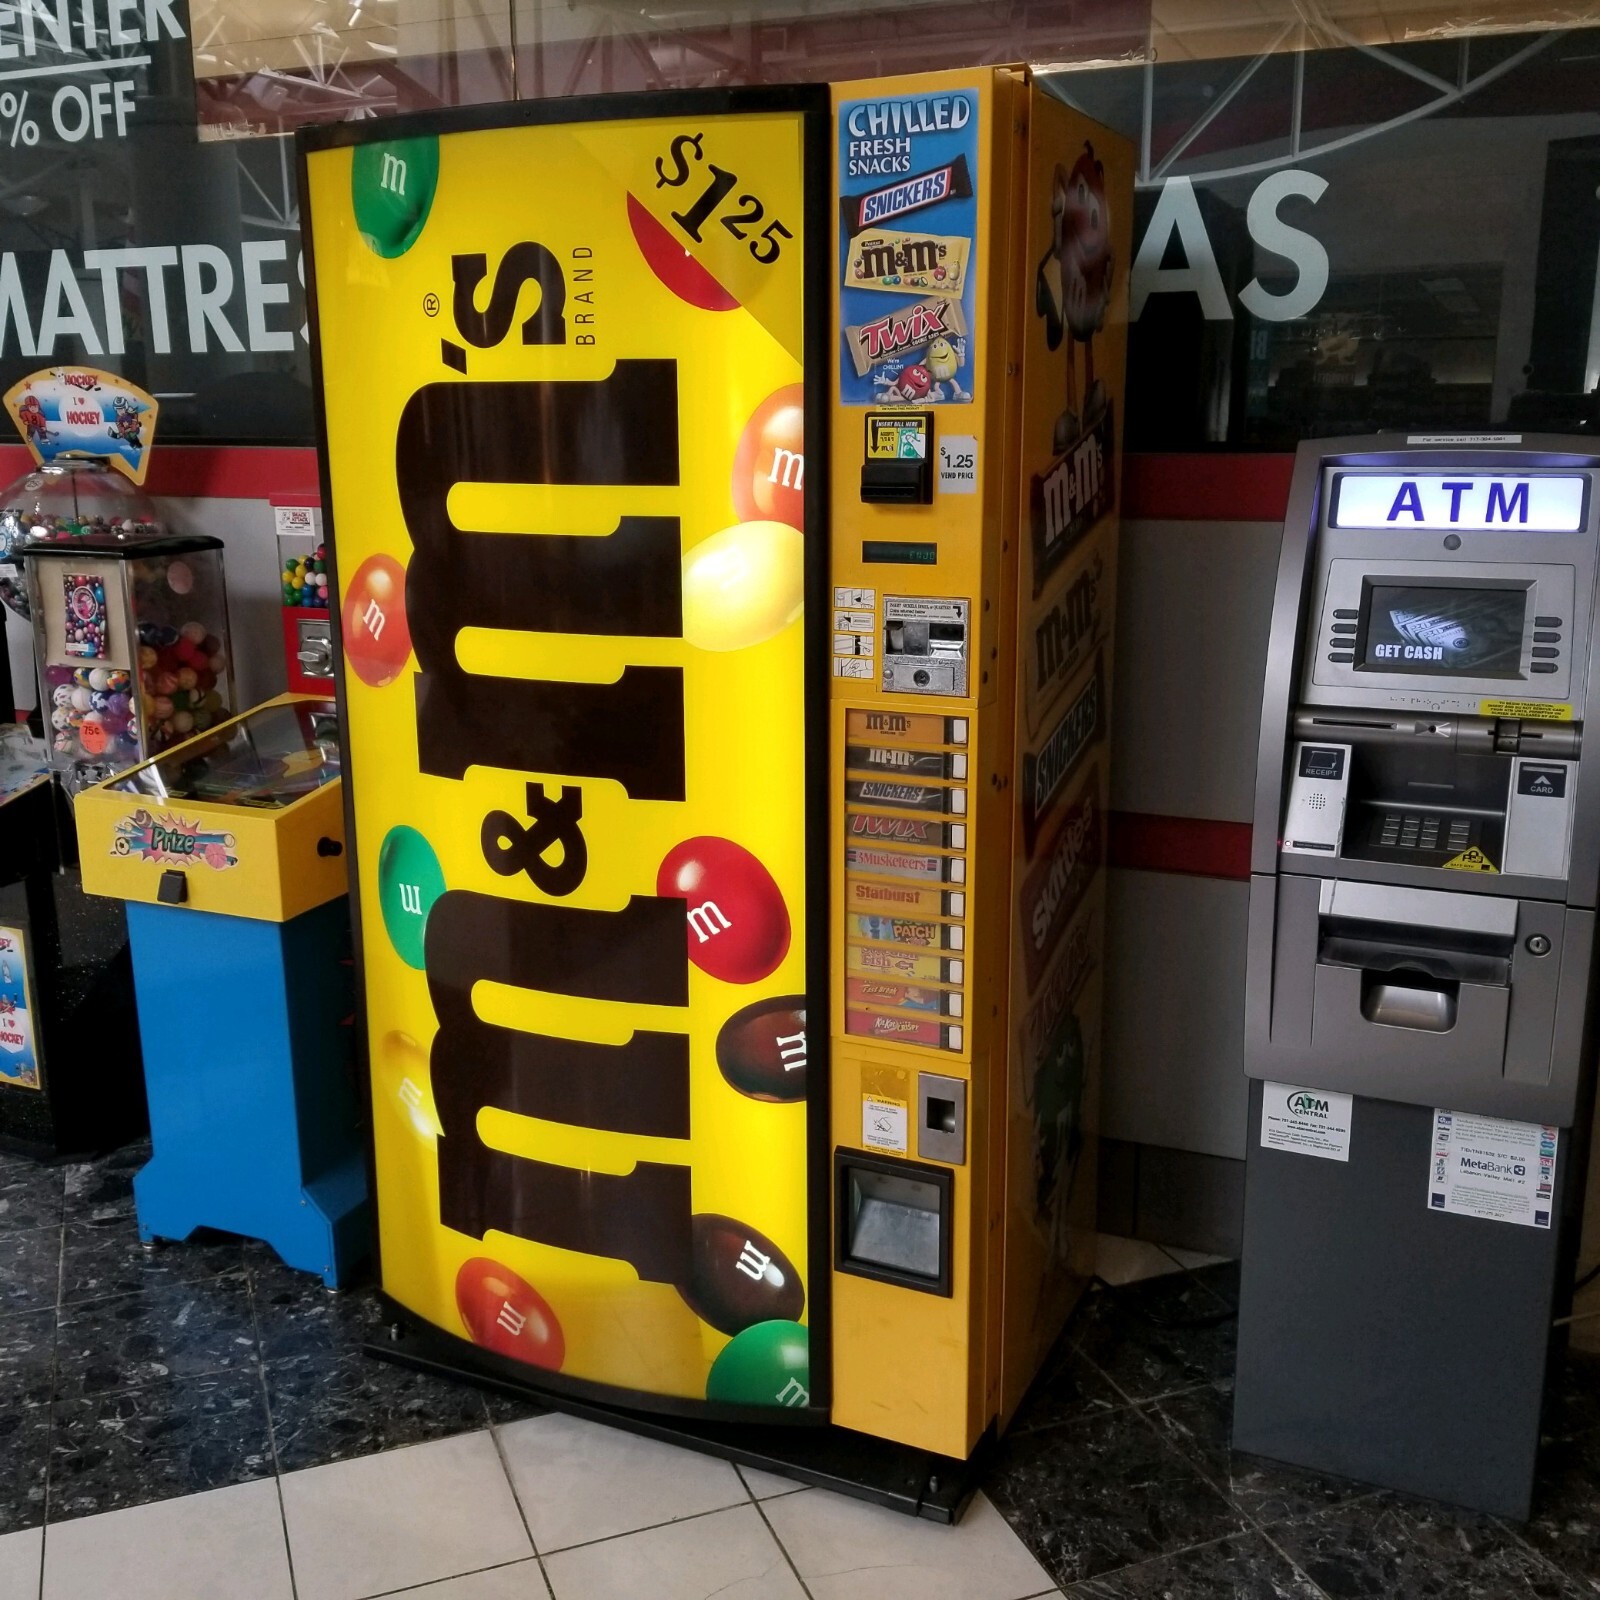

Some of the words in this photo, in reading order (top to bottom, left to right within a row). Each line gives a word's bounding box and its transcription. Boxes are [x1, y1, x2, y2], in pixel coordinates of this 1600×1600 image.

[51, 80, 136, 142] OFF
[848, 95, 971, 137] CHILLED
[849, 137, 911, 157] FRESH
[381, 151, 407, 195] m
[848, 156, 911, 176] SNACKS
[864, 170, 946, 223] SNICKERS
[571, 245, 597, 347] BRAND
[64, 374, 99, 386] HOCKEY
[66, 411, 100, 425] HOCKEY
[940, 446, 974, 468] $1.25
[1386, 481, 1530, 524] ATM
[363, 598, 387, 641] m
[1375, 643, 1402, 658] GET
[1404, 645, 1443, 660] CASH
[83, 725, 101, 737] 75¢
[1305, 768, 1338, 777] RECEIPT
[863, 781, 923, 801] SNICKERS
[1530, 785, 1554, 794] CARD
[151, 825, 196, 855] Prize
[399, 882, 423, 917] m
[856, 885, 921, 904] Starburst
[686, 898, 733, 943] m
[892, 925, 937, 940] PATCH
[1293, 1095, 1329, 1112] ATM
[1294, 1108, 1328, 1119] CENTRAL
[1460, 1157, 1513, 1174] MetaBank
[735, 1239, 771, 1282] m
[496, 1301, 528, 1337] m
